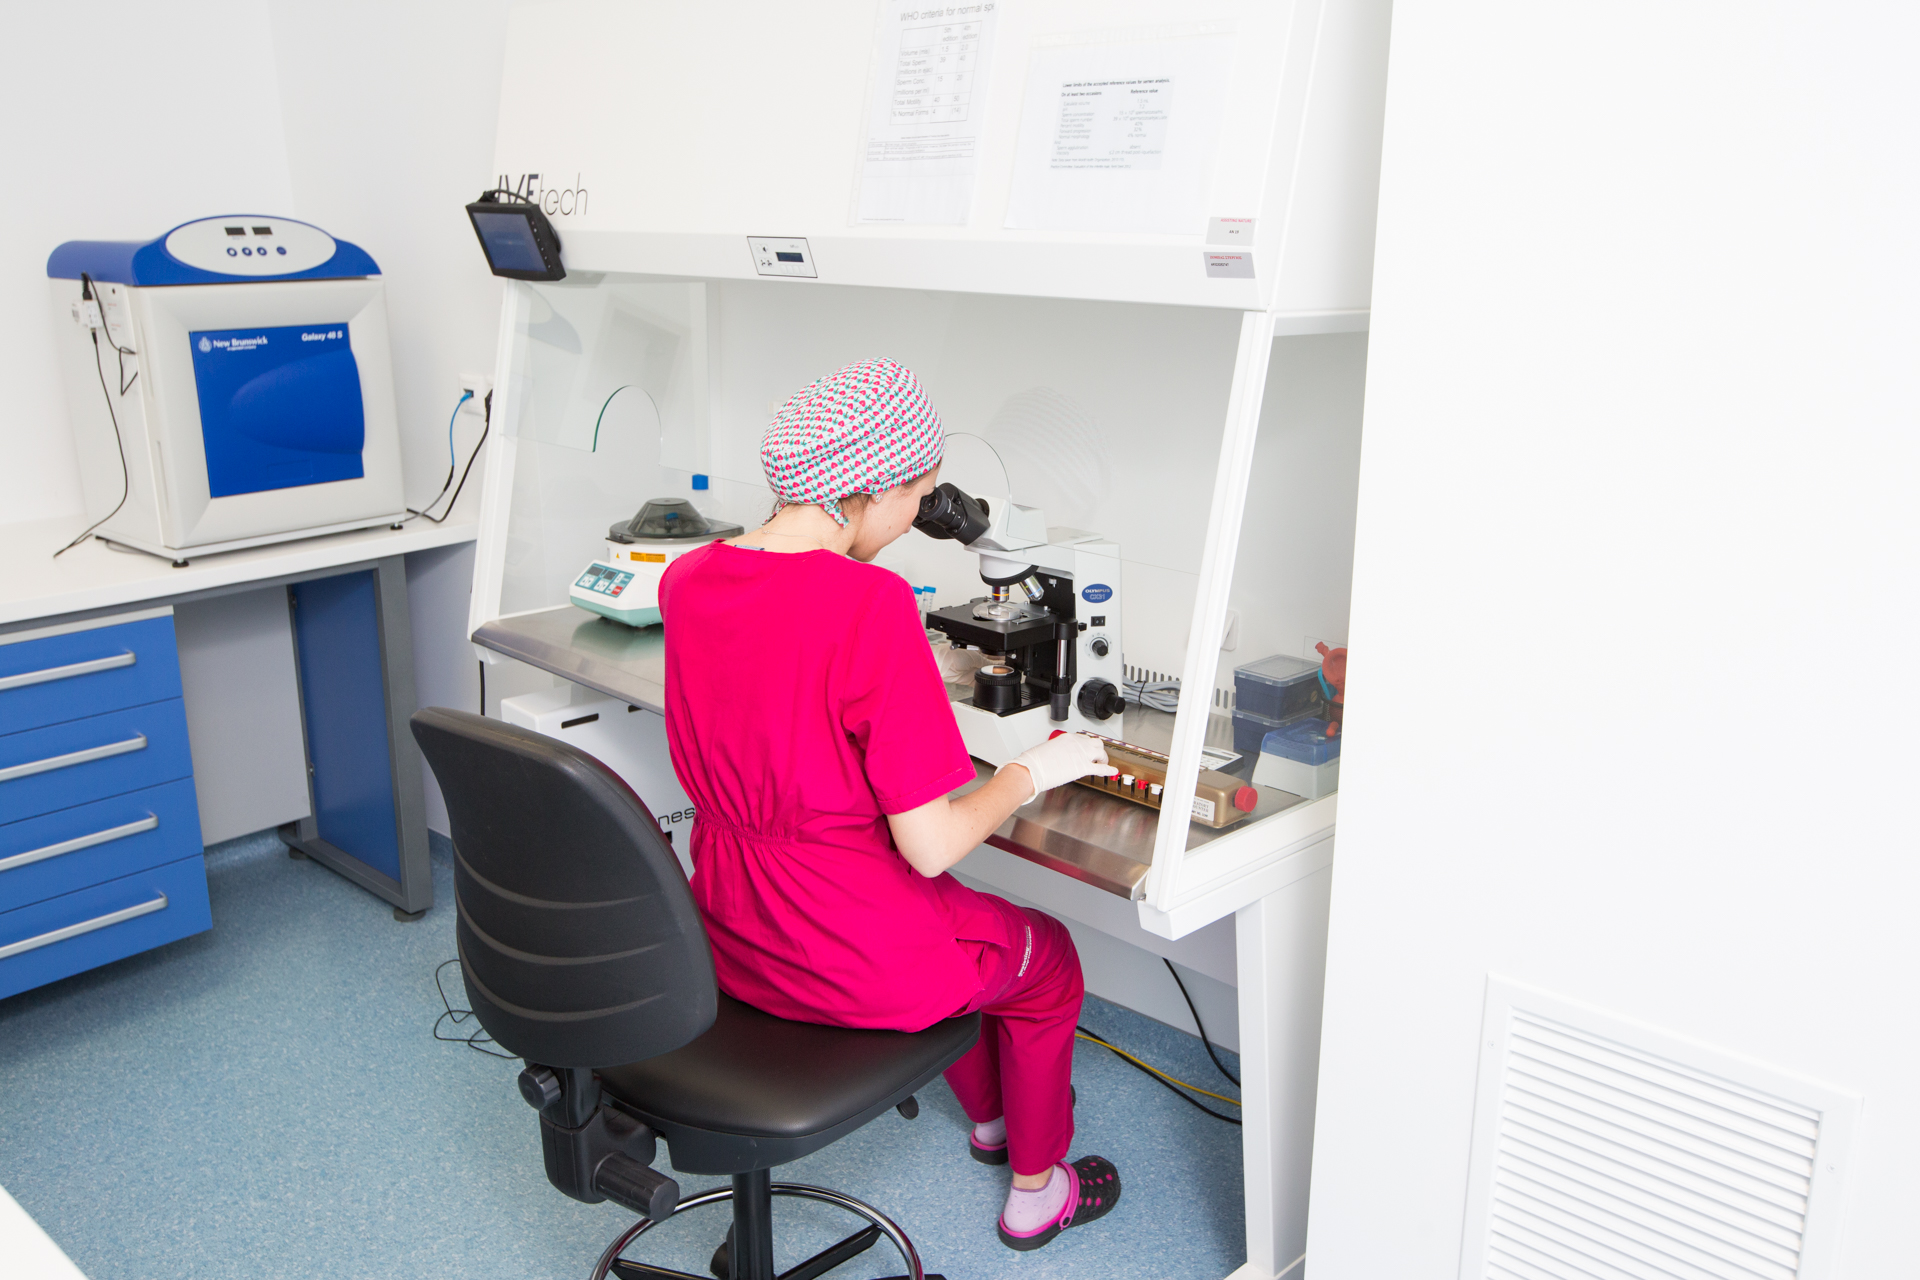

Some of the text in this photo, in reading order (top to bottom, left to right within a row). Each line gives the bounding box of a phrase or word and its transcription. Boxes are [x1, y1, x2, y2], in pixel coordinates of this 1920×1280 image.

[900, 11, 919, 21] WHO
[920, 8, 944, 19] criteria
[945, 7, 956, 16] for
[957, 3, 982, 15] normal
[911, 59, 927, 67] Sperm
[213, 339, 230, 349] New
[231, 335, 268, 347] Brunswick
[301, 330, 343, 342] Galaxy 48 S
